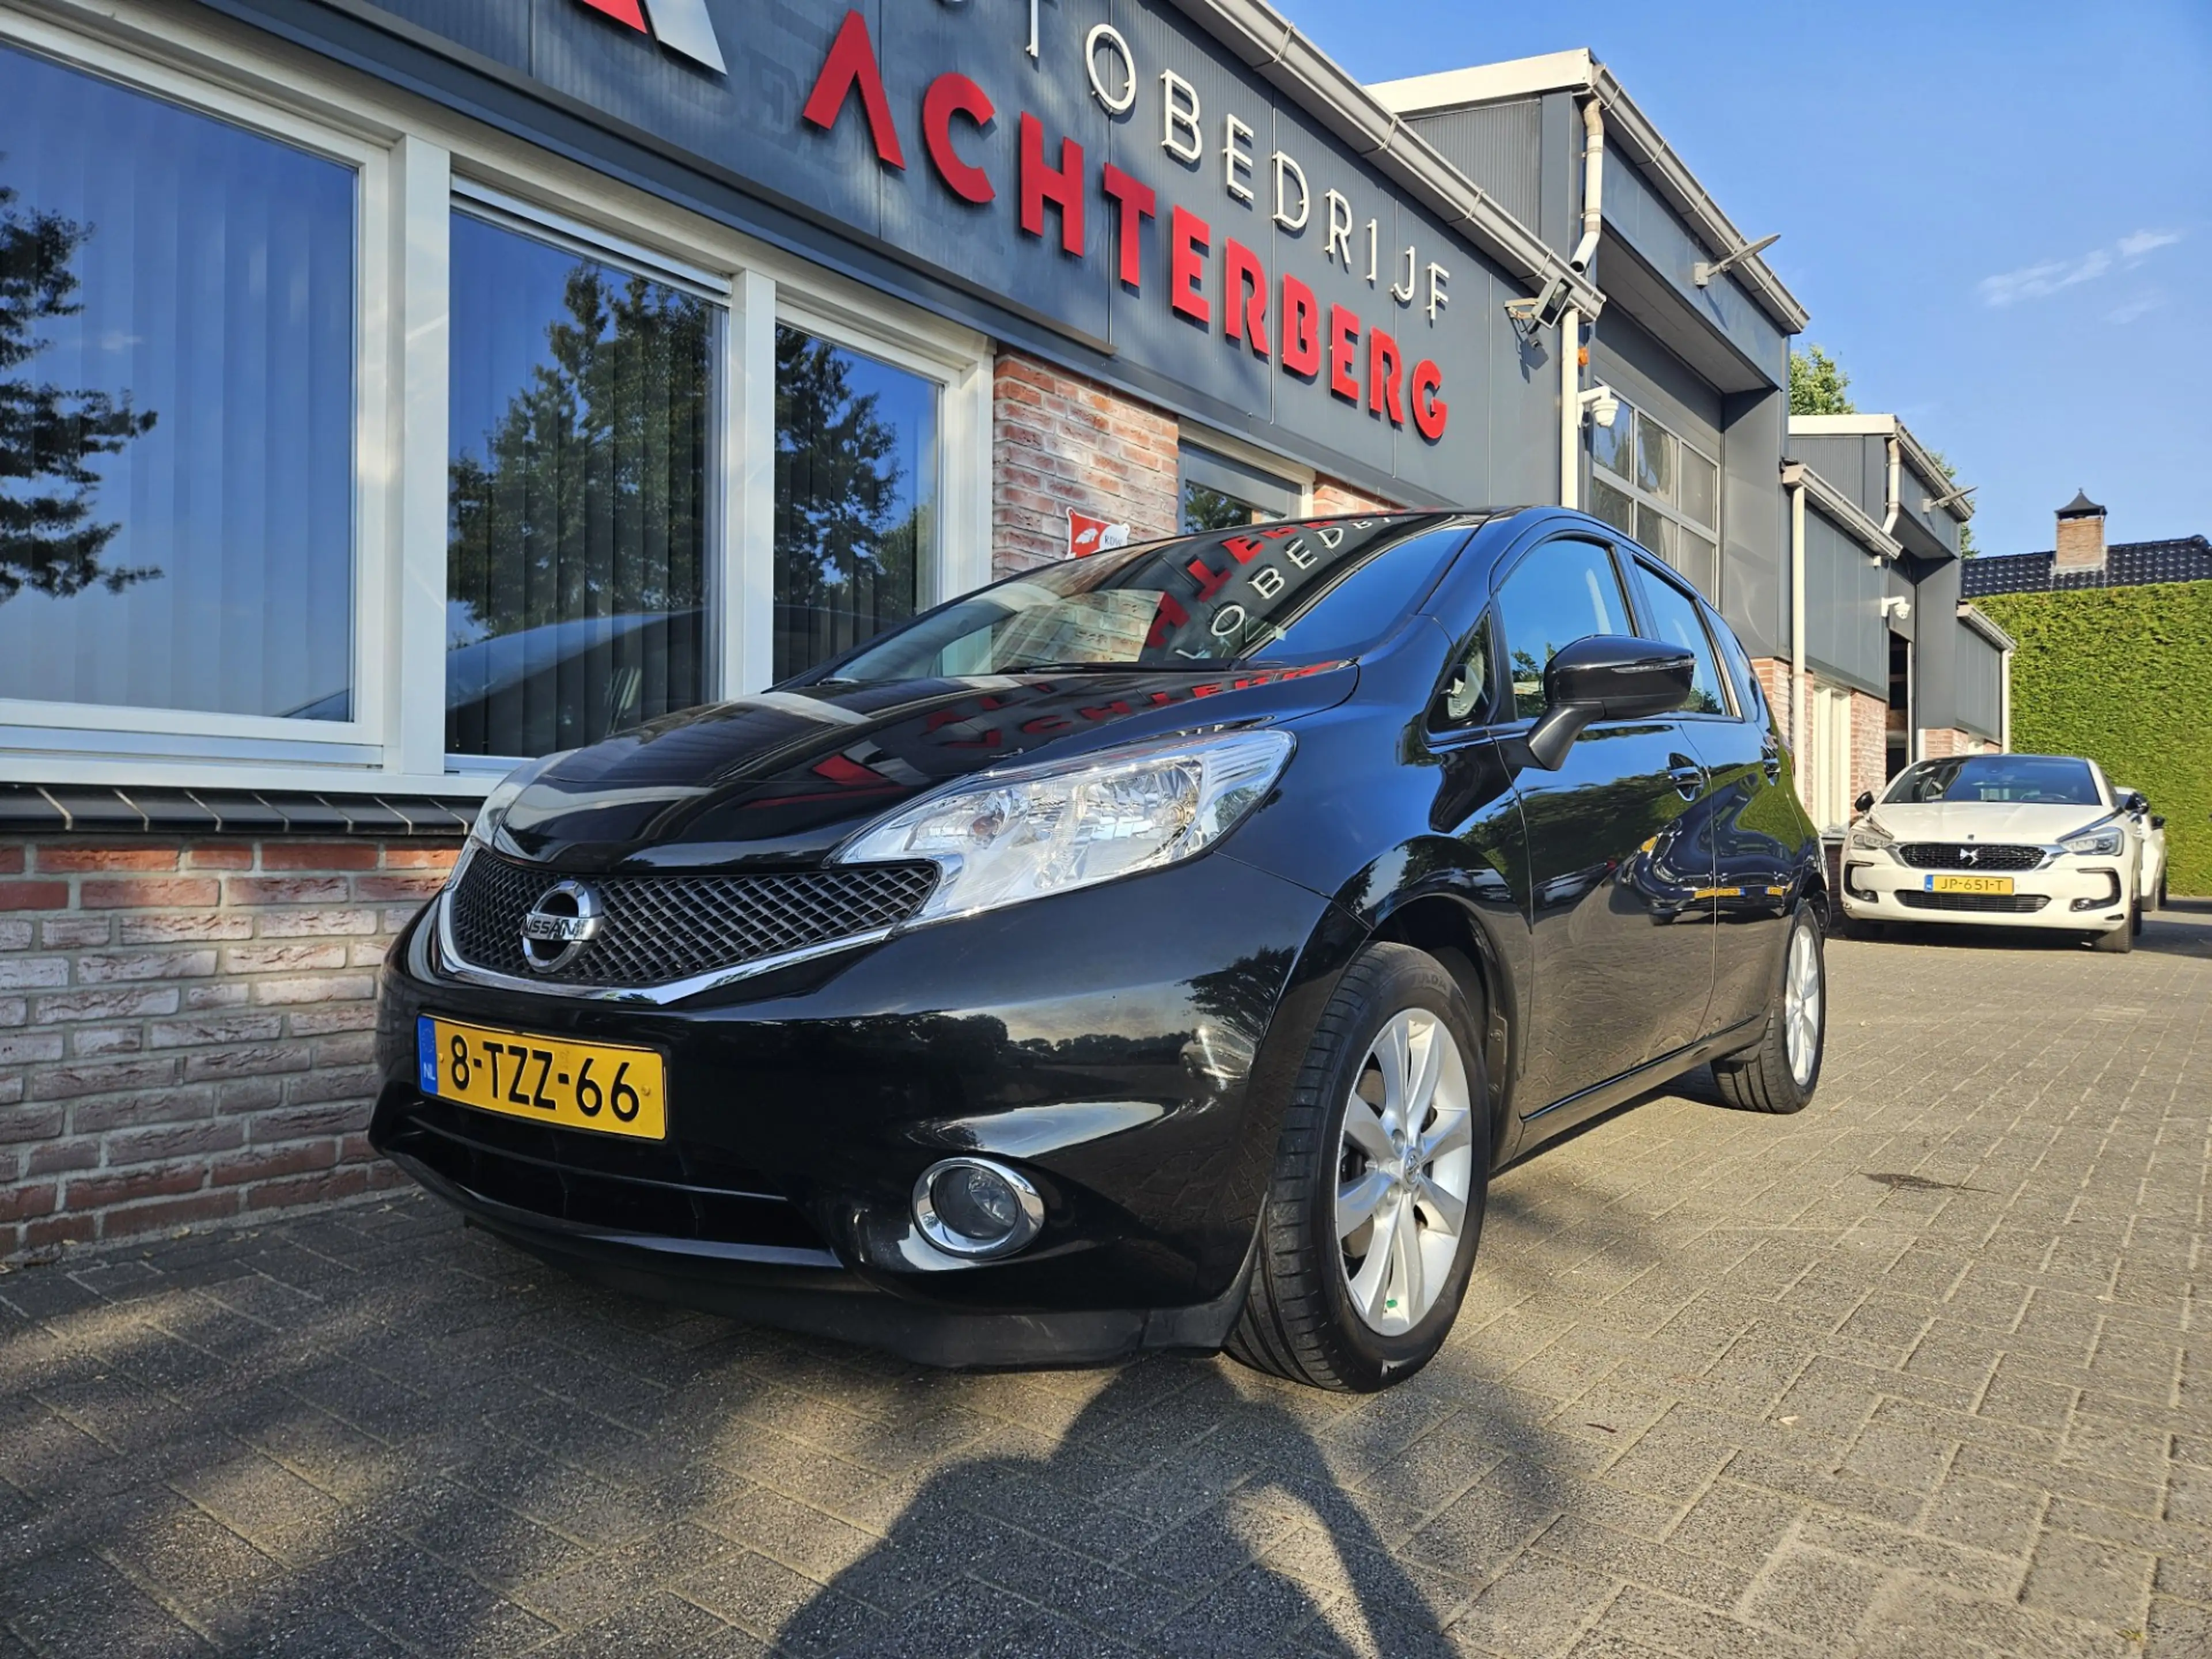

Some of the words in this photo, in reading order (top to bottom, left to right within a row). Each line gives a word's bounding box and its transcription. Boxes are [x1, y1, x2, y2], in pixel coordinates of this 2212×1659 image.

[803, 9, 1448, 440] ACHTERBERG
[1941, 878, 2004, 891] JP-651-T
[423, 1062, 436, 1081] NL
[451, 1035, 639, 1122] 8-TZZ-66
